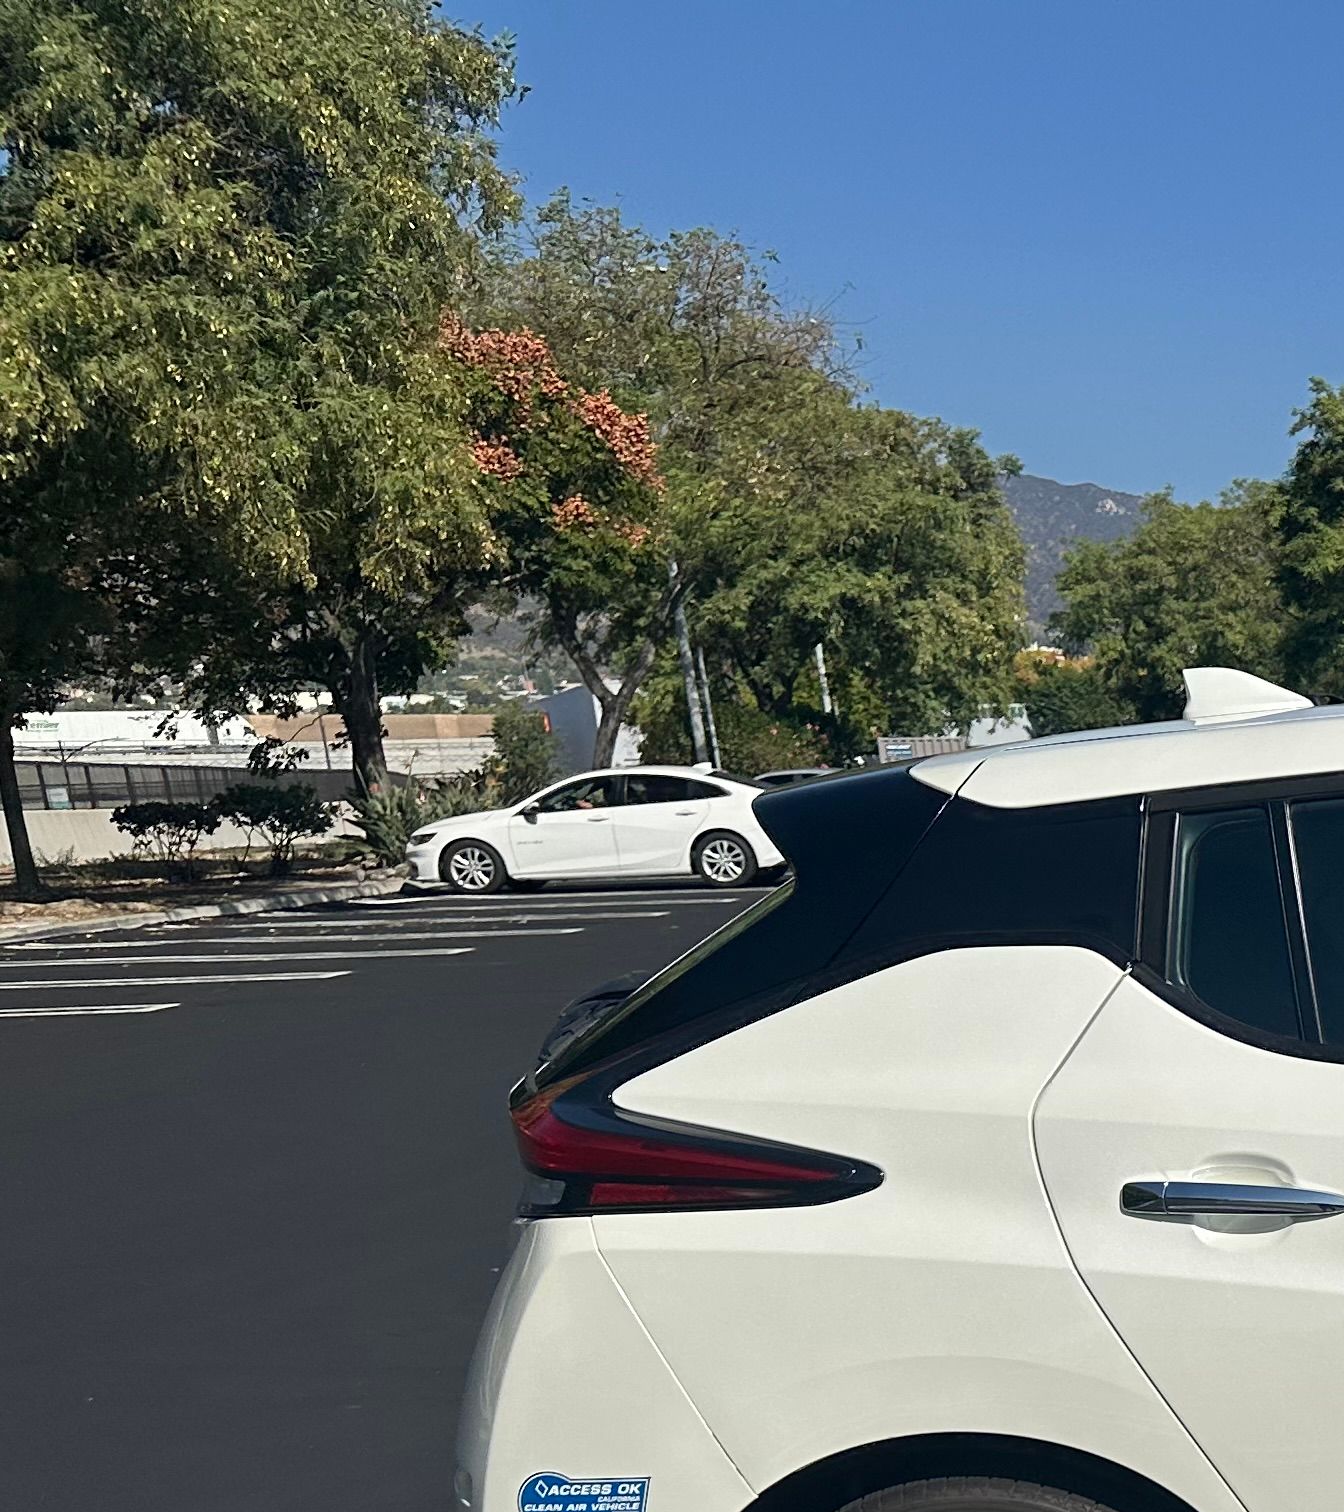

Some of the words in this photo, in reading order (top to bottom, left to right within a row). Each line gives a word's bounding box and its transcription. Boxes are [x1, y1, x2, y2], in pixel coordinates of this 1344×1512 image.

[548, 1484, 612, 1496] ACCESS
[617, 1483, 642, 1495] OK
[524, 1503, 563, 1512] CLEAN
[566, 1503, 587, 1511] AIR
[591, 1502, 640, 1511] VEHICLE
